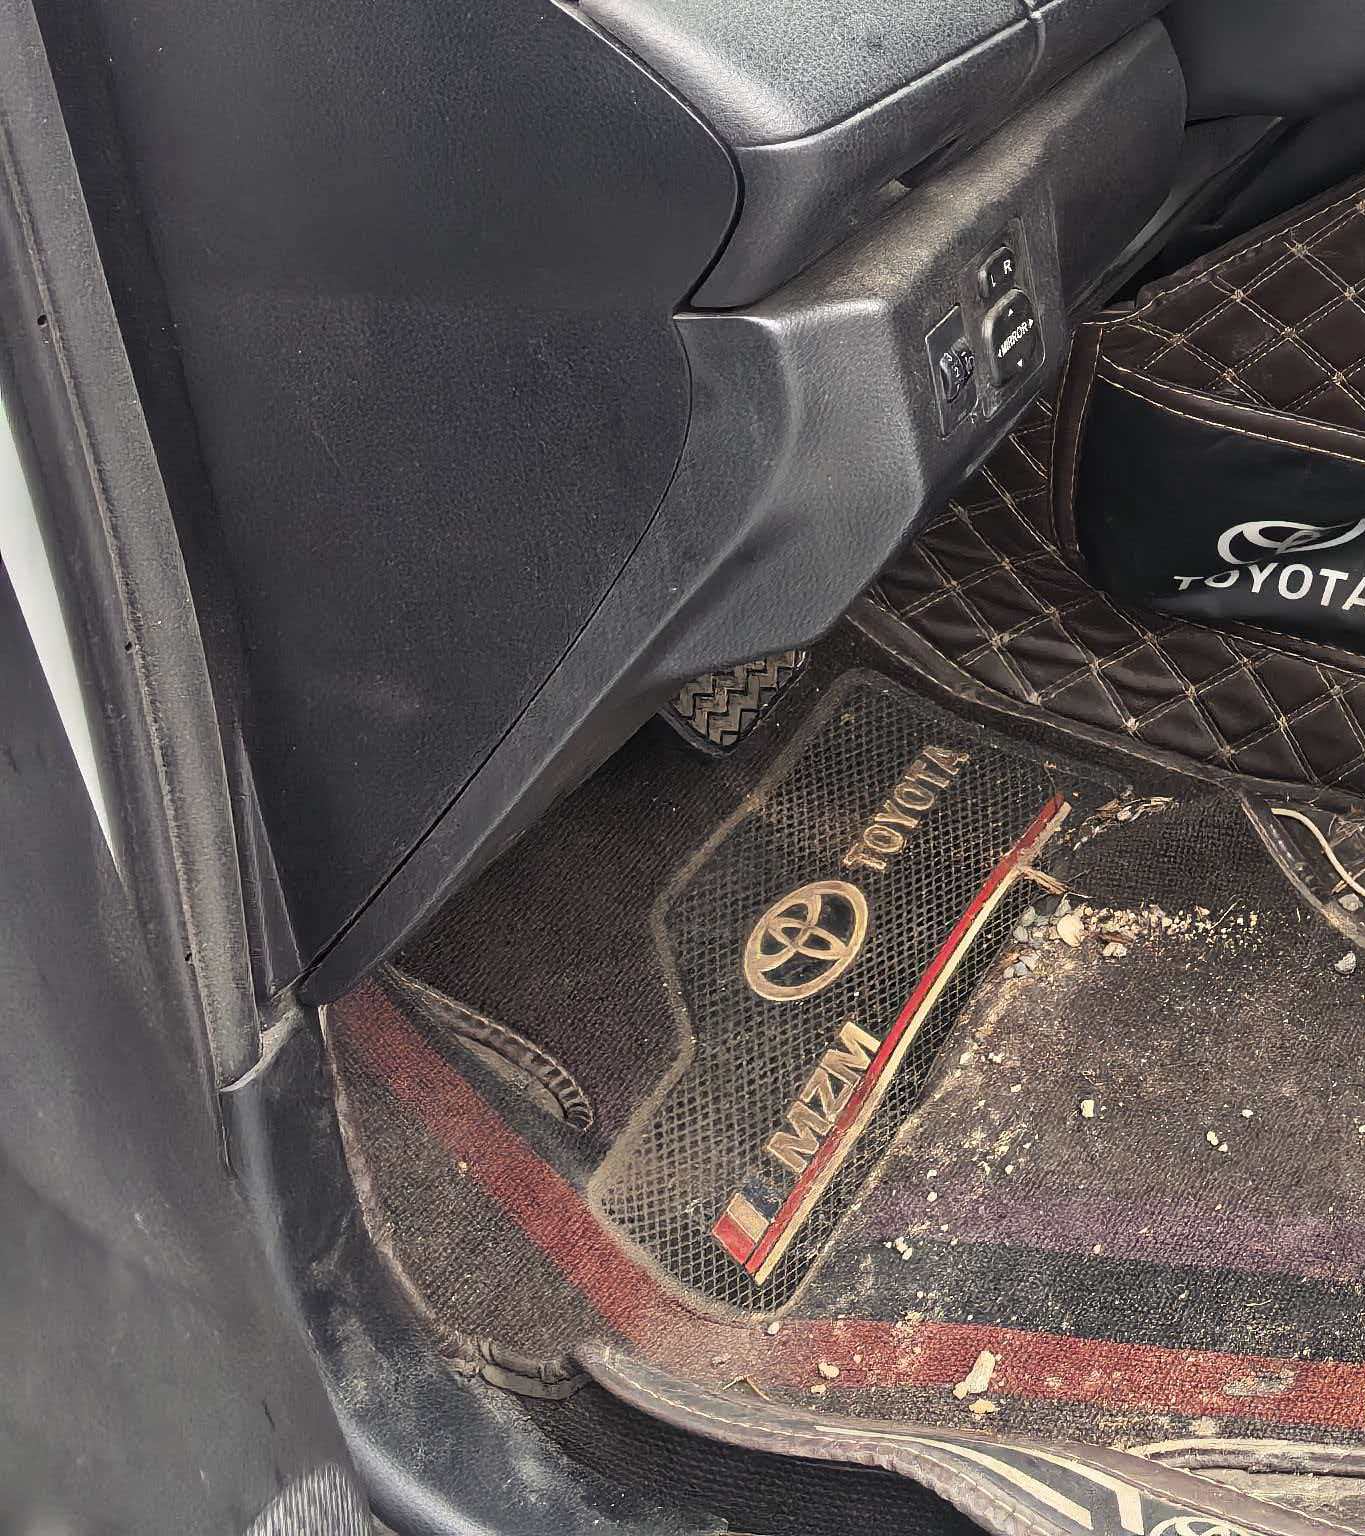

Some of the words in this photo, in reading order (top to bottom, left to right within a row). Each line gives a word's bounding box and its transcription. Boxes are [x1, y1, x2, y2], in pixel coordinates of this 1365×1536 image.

[1003, 259, 1013, 274] R
[1001, 321, 1028, 356] MIRROR
[843, 744, 971, 872] TOYOTA
[762, 1020, 883, 1173] MZM
